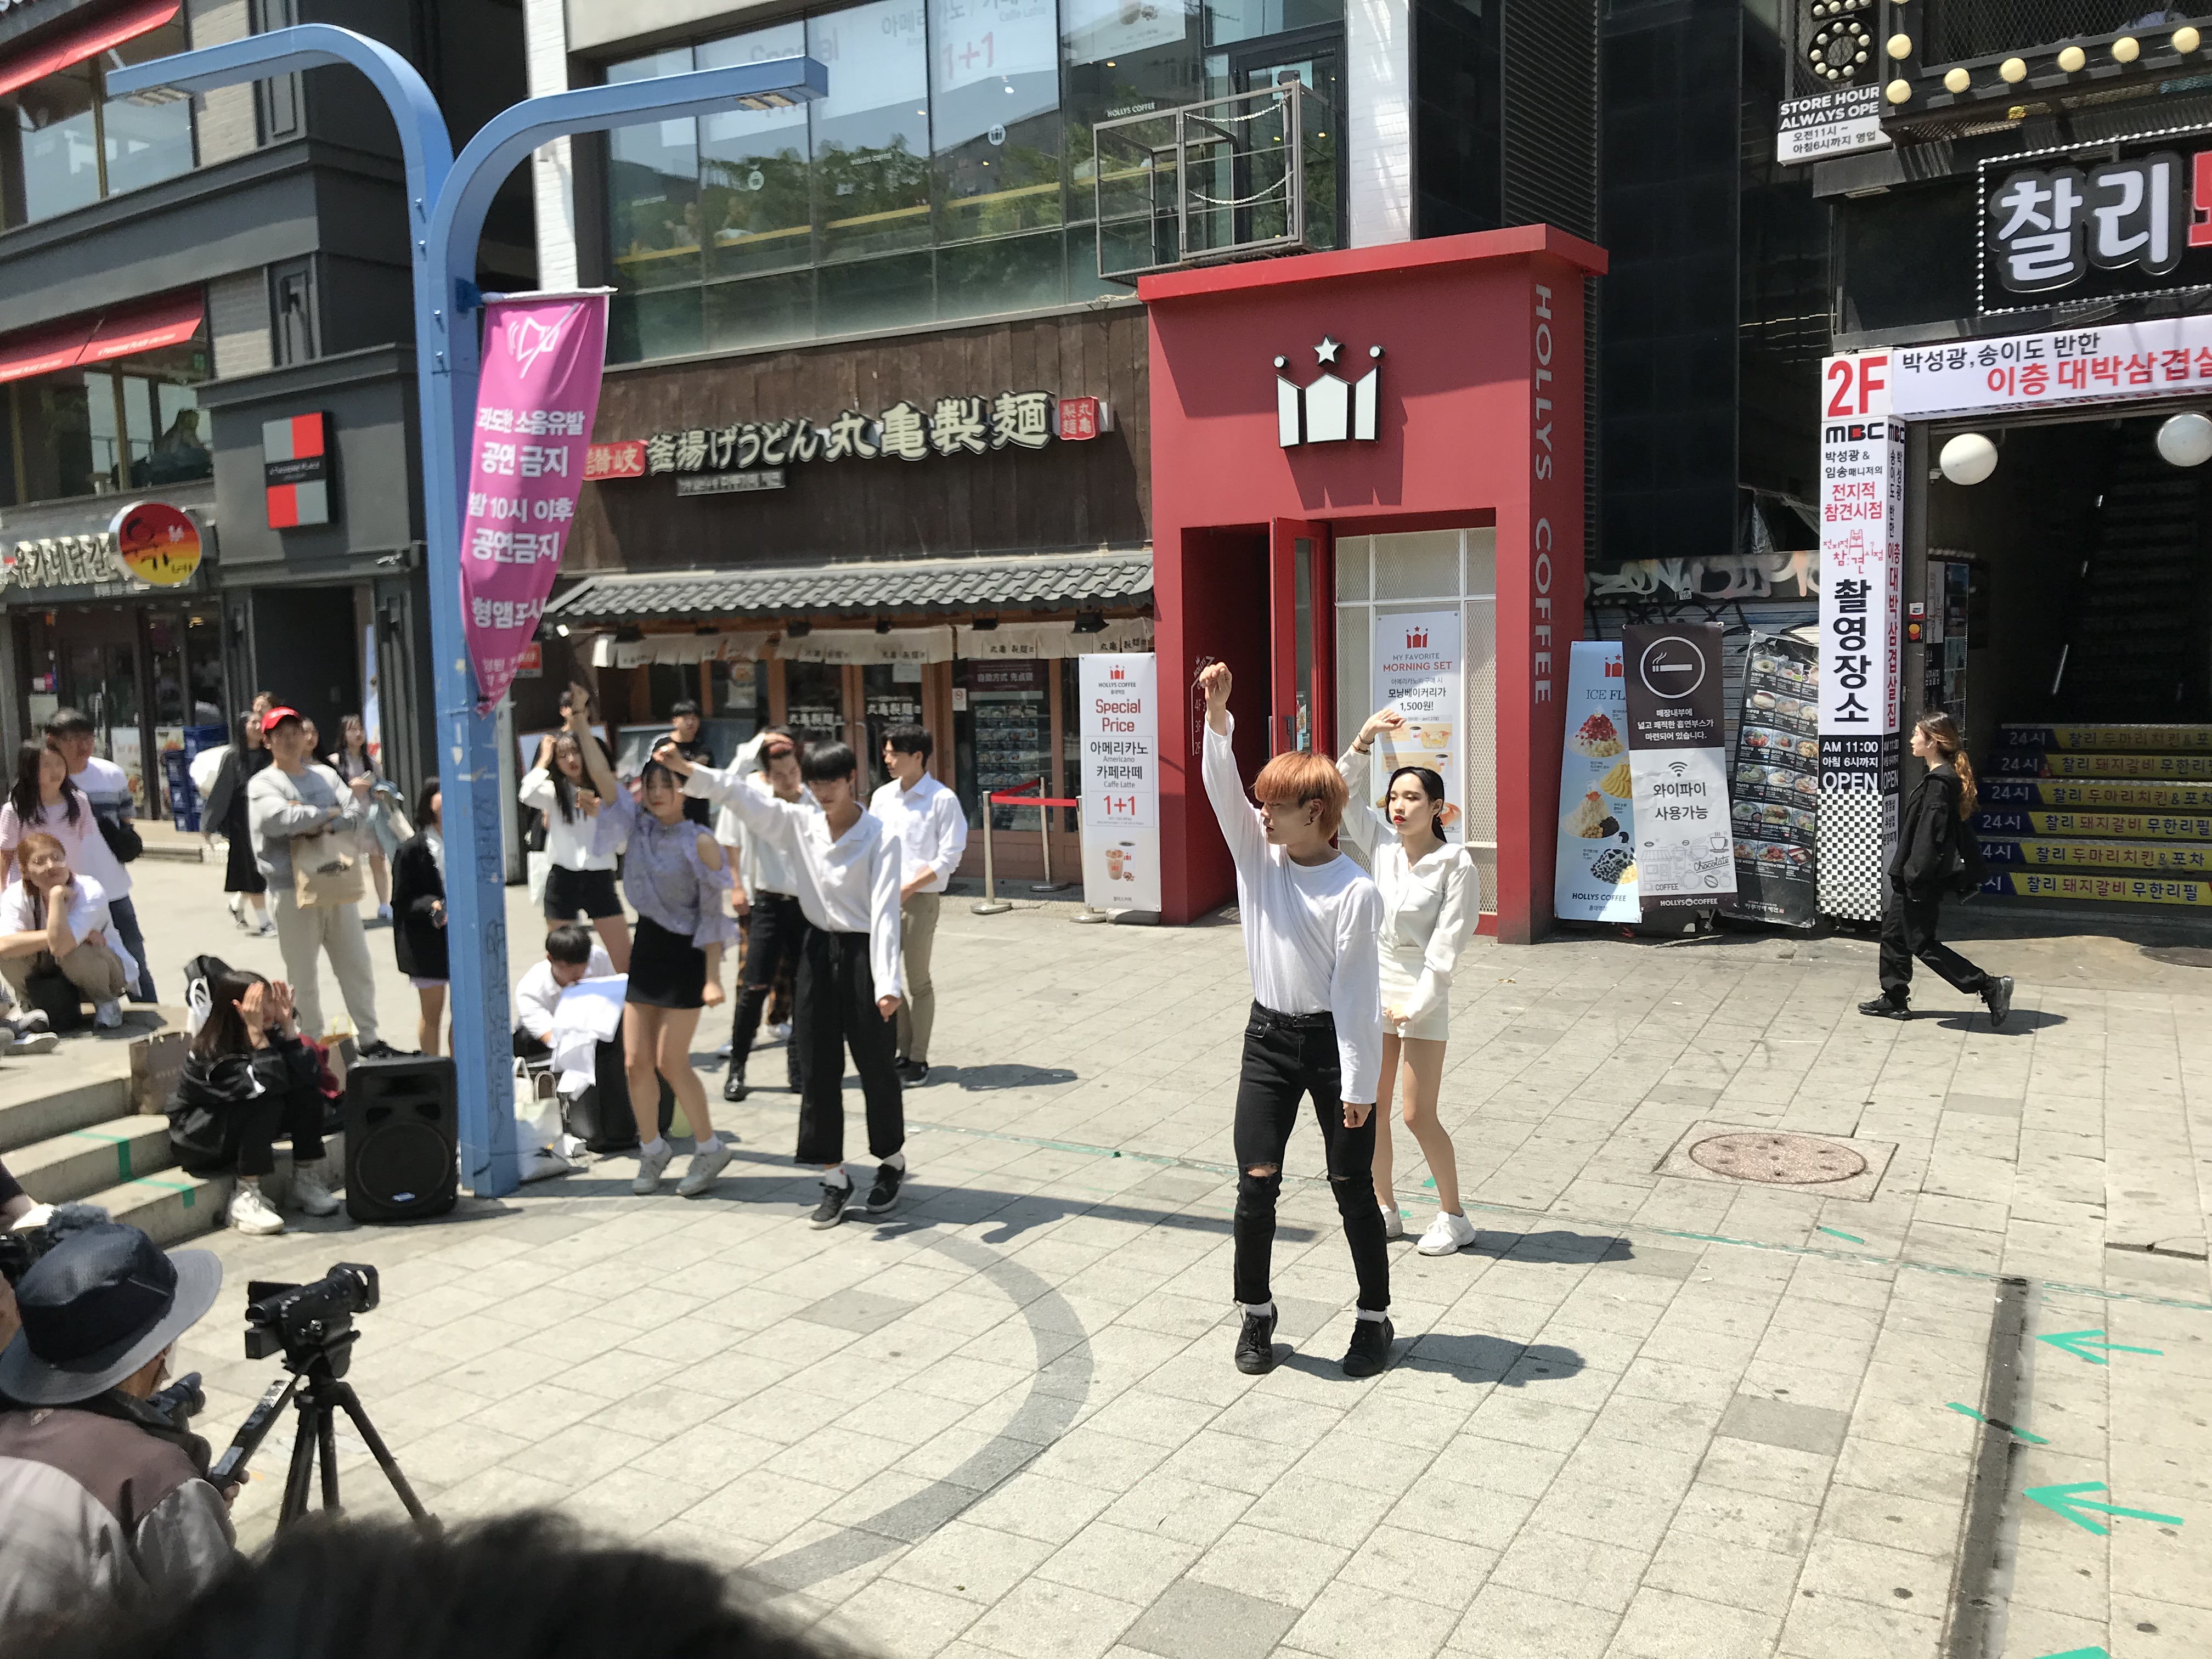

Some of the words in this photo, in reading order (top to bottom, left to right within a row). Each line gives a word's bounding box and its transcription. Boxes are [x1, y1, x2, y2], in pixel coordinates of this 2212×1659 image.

[1107, 106, 1131, 118] HOLLYS
[1132, 102, 1156, 114] COFFEE
[1780, 95, 1832, 116] STORE
[1835, 86, 1880, 106] HOUR
[1780, 108, 1846, 131] ALWAYS
[1848, 101, 1880, 117] OPE
[1793, 125, 1837, 142] 오전11시
[1793, 135, 1852, 154] 아침6시까지
[1855, 131, 1876, 144] 영업
[1998, 162, 2170, 283] 찰리
[2054, 332, 2101, 359] 반한
[1536, 283, 1553, 481] HOLLYS
[1827, 356, 1889, 419] 2F
[1987, 363, 2050, 397] 이층
[515, 410, 586, 436] 소음유발
[1825, 422, 1884, 443] MBC
[481, 441, 516, 476] 공연
[520, 445, 569, 478] 금지
[1825, 449, 1860, 463] 박성광
[1863, 451, 1870, 460] &
[1832, 481, 1876, 502] 전지적
[490, 496, 528, 523] 10시
[533, 497, 574, 523] 이후
[1824, 500, 1883, 522] 참견시점
[472, 527, 560, 565] 공연금지
[15, 536, 115, 585] 유가네닭갈
[1534, 517, 1552, 705] COFFEE
[1405, 652, 1440, 661] FAVORITE
[1832, 578, 1872, 723] 촬영장소
[1383, 662, 1431, 672] MORNING
[1434, 661, 1453, 670] SET
[1388, 687, 1447, 698] 모닝베이커리가
[1586, 689, 1606, 700] ICE
[1095, 698, 1141, 714] Special
[1194, 699, 1201, 712] 4F
[1400, 701, 1434, 712] 1,500원!
[1656, 708, 1694, 718] 매장내부에
[1102, 717, 1135, 732] Price
[1194, 720, 1201, 733] 3F
[1645, 732, 1674, 741] 마련되어
[1675, 731, 1707, 740] 있습니다.
[2010, 731, 2046, 746] 24시
[2068, 732, 2097, 748] 찰리
[1090, 741, 1148, 755] 아메리카노
[1822, 741, 1841, 753] AM
[1846, 741, 1879, 753] 11:00
[1822, 756, 1841, 768] 아침
[1844, 756, 1878, 768] 6시까지
[2001, 757, 2038, 771] 24시
[2062, 757, 2090, 772] 찰리
[2095, 757, 2155, 775] 돼지갈비
[2160, 758, 2212, 775] 무한리
[1096, 765, 1142, 780] 카페라떼
[1822, 772, 1878, 790] OPEN
[1653, 782, 1707, 799] 와이파이
[1991, 785, 2029, 800] 24시
[2053, 788, 2082, 804] 찰리
[1103, 795, 1135, 816] 1+1
[1655, 805, 1709, 821] 사용가능
[1982, 814, 2021, 830] 24시
[2045, 815, 2074, 831] 찰리
[2079, 816, 2141, 833] 돼지갈비
[2147, 818, 2210, 837] 무한리필
[1694, 855, 1729, 872] Chocolate
[1979, 844, 2011, 860] 4시
[2036, 846, 2066, 863] 찰리
[2072, 848, 2154, 867] 두마리치킨
[2172, 851, 2205, 867] 포차
[1572, 893, 1599, 901] HOLLYS
[2027, 876, 2056, 894] 찰리
[2062, 878, 2126, 896] 돼지갈비
[2132, 882, 2197, 902] 무한리필
